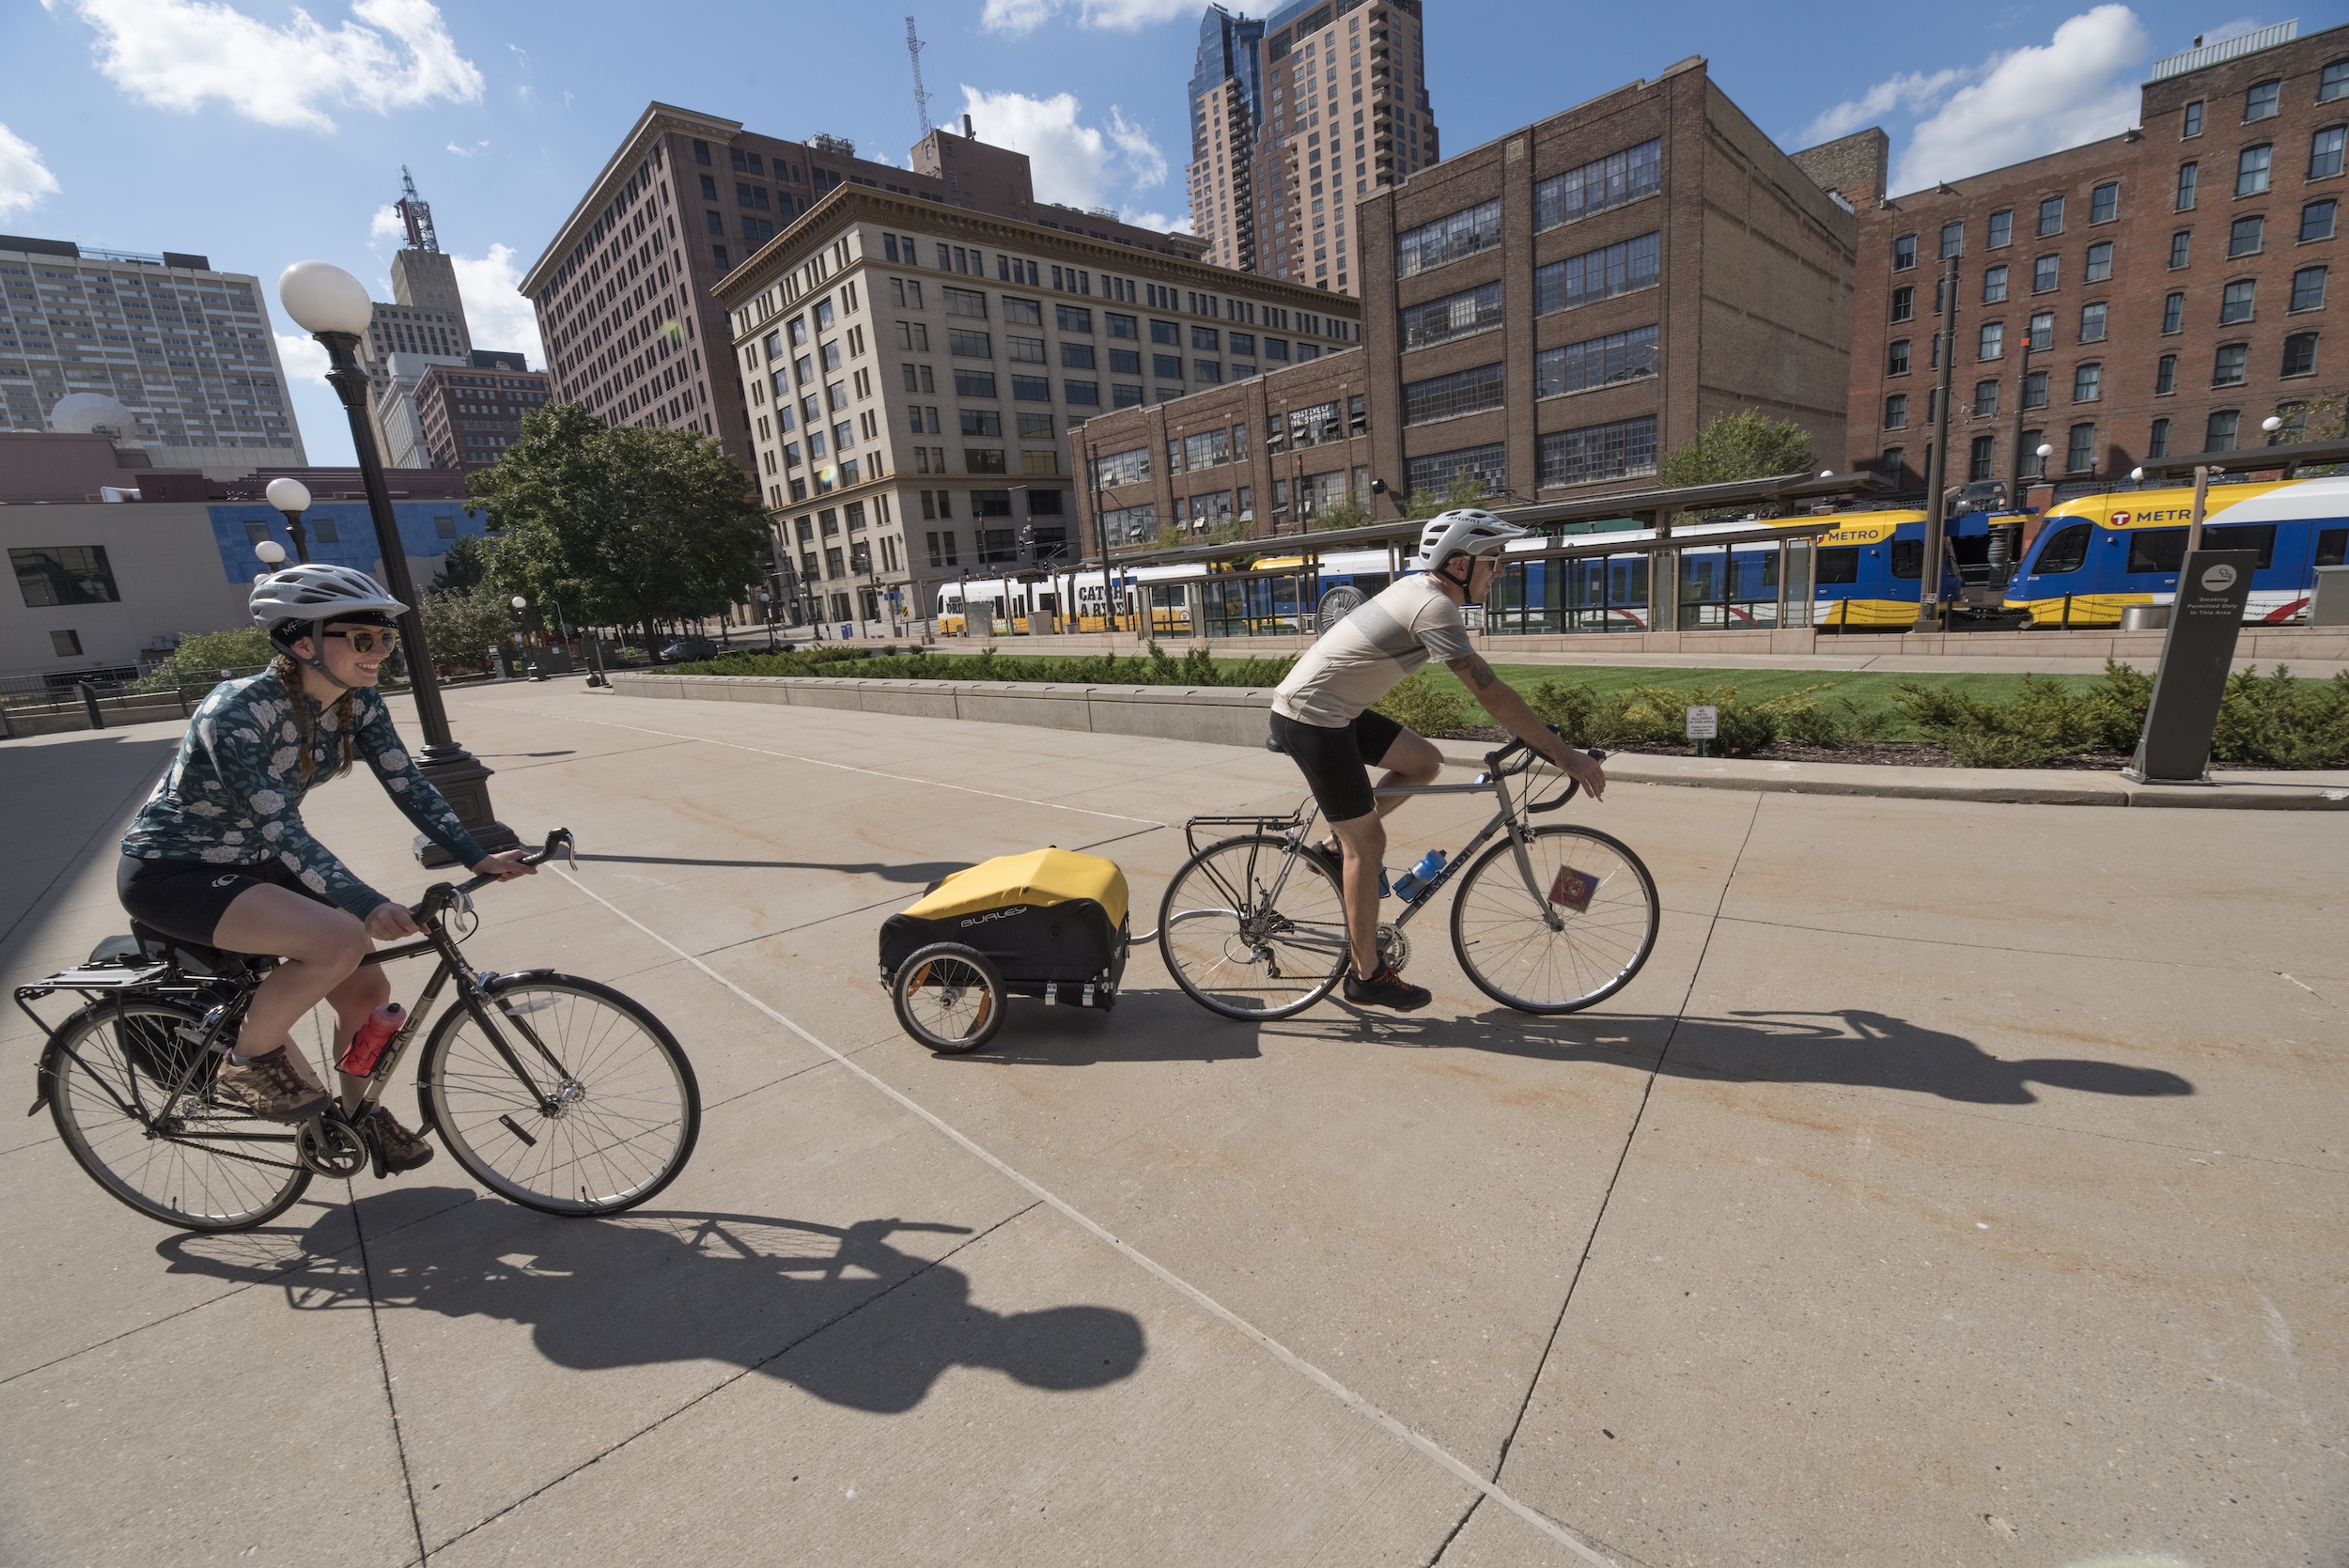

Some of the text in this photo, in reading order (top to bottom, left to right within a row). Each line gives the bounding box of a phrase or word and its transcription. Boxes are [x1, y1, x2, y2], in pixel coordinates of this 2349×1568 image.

[1288, 403, 1330, 421] POSITIVELY
[1304, 411, 1330, 425] Street
[1828, 530, 1879, 541] METRO
[1079, 584, 1123, 601] CATH
[1081, 603, 1089, 617] A
[960, 905, 1028, 928] BURLEY
[374, 1016, 419, 1083] REDLINE
